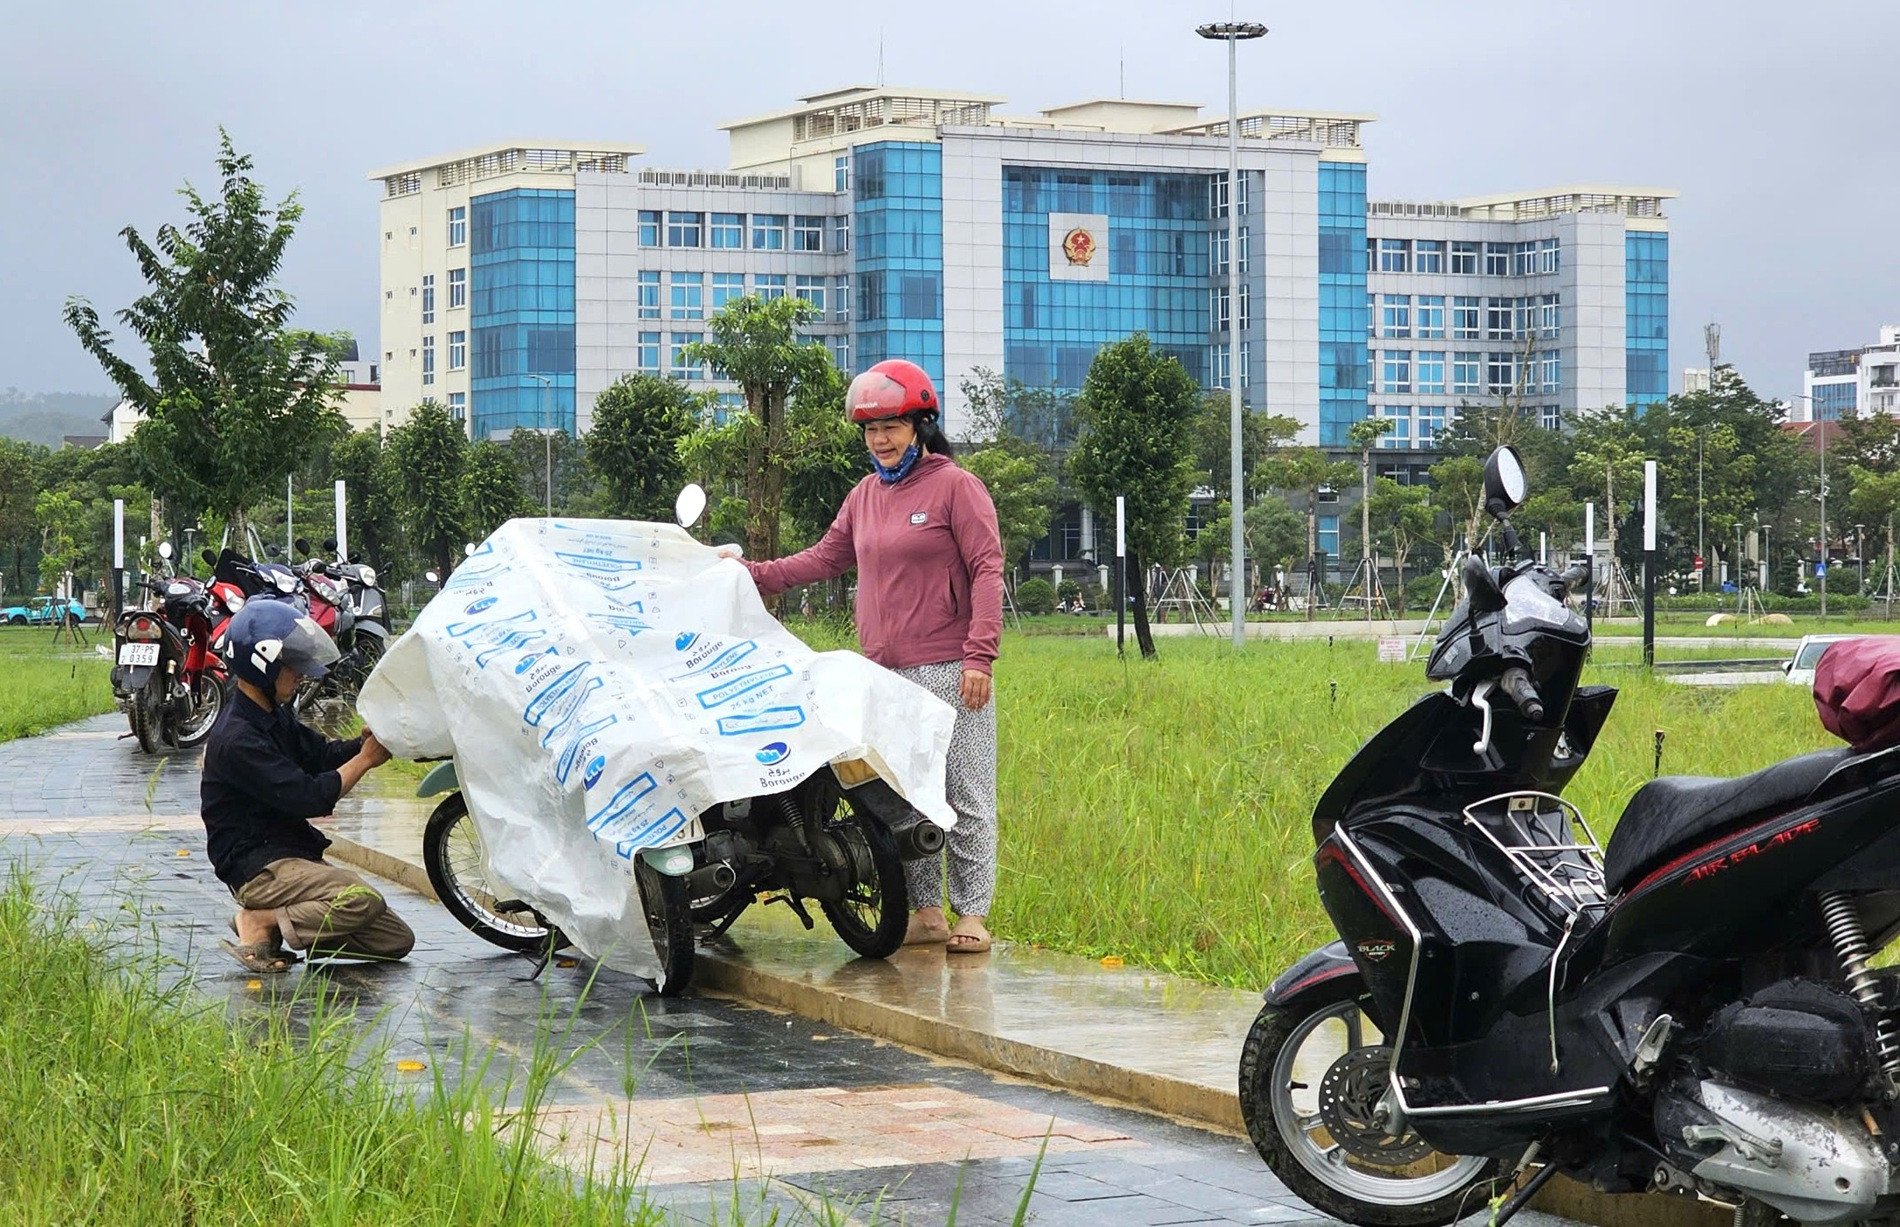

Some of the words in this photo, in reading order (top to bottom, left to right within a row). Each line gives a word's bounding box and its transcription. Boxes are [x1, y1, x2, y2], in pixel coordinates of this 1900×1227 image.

[685, 640, 724, 669] Borouge
[755, 684, 775, 699] NET
[1357, 944, 1396, 953] BLACK
